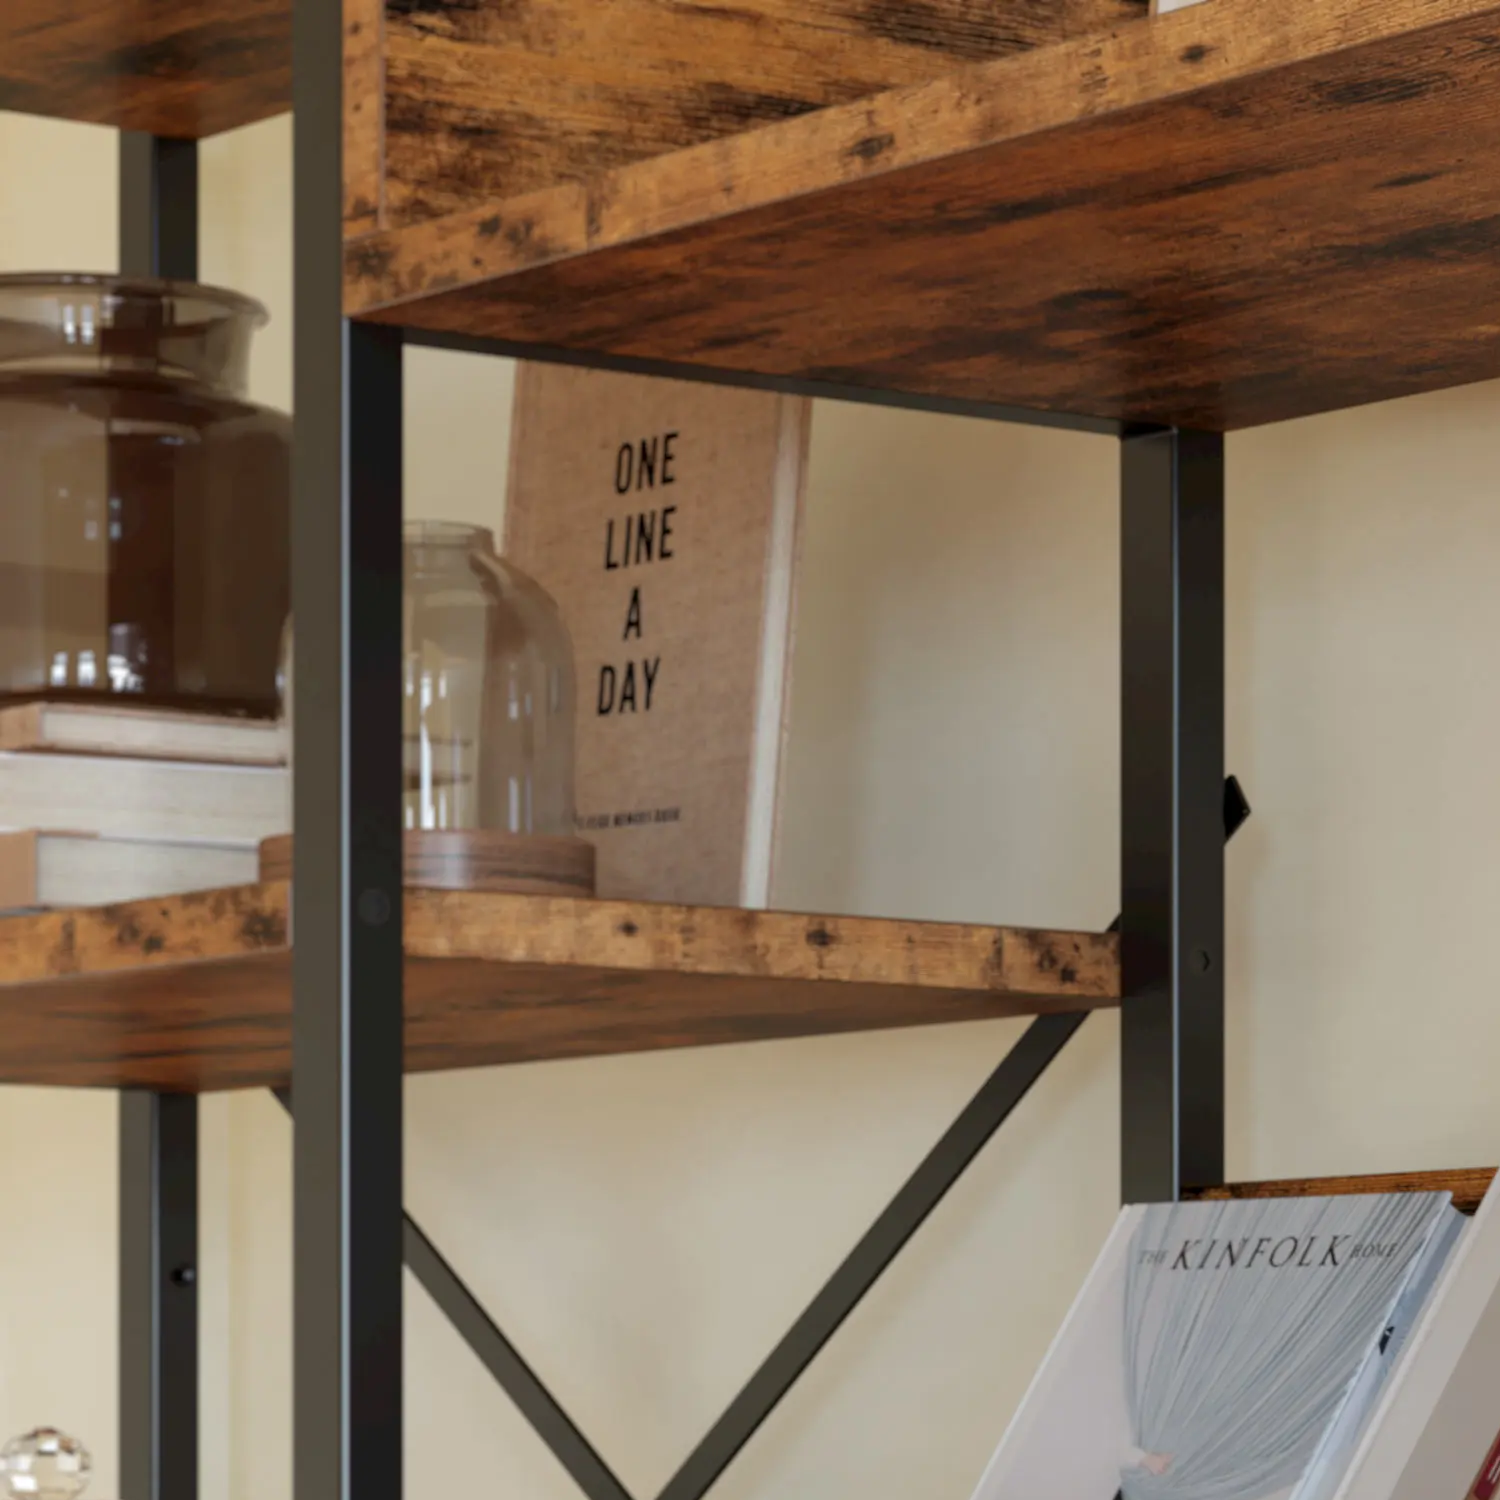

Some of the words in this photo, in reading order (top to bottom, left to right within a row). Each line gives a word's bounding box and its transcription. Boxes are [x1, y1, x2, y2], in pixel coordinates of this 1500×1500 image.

[614, 432, 679, 494] ONE
[605, 506, 677, 571] LINE
[623, 586, 642, 641] A
[597, 656, 661, 716] DAY
[1171, 1235, 1352, 1270] KINFOLK
